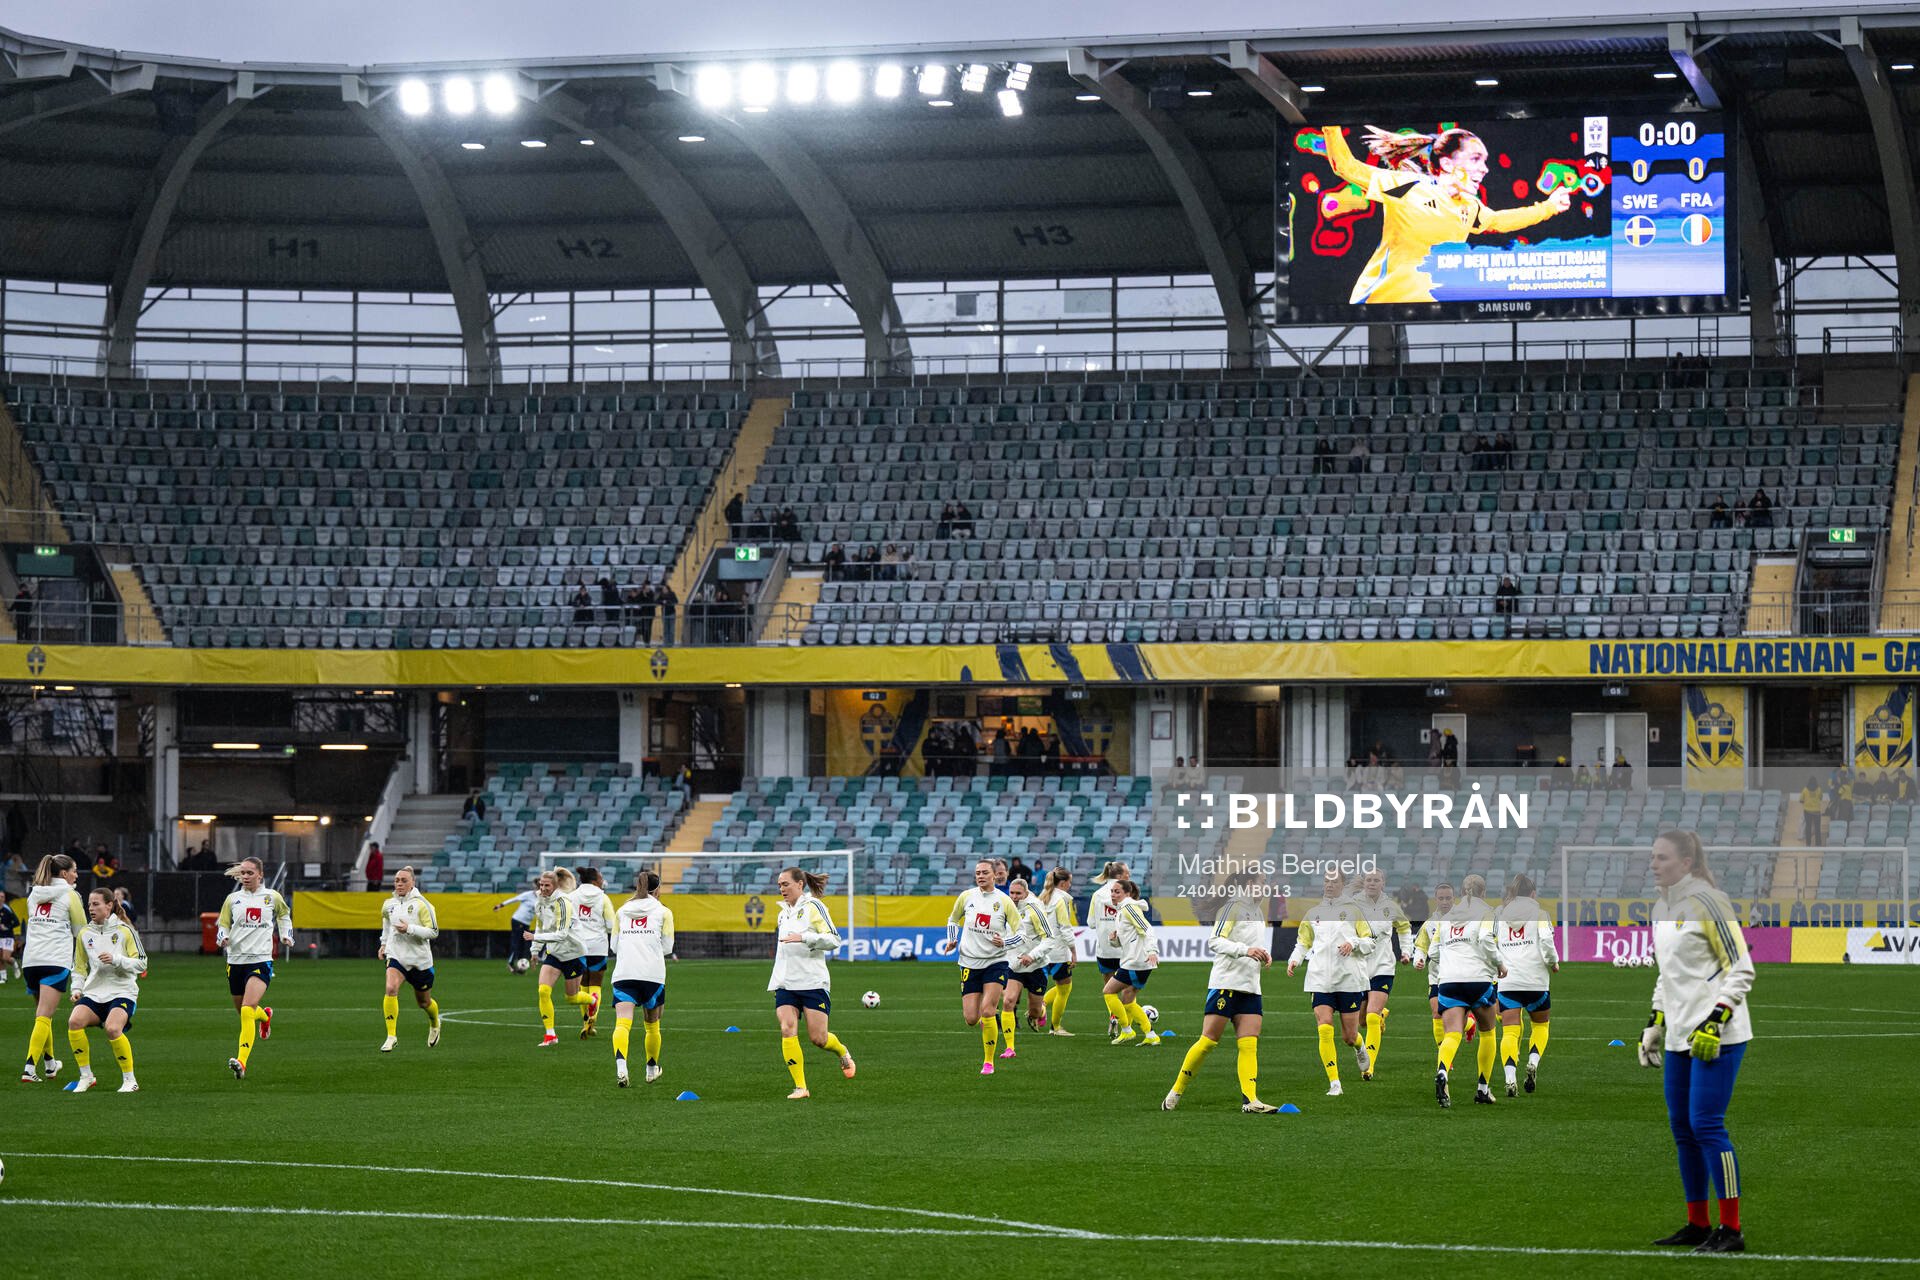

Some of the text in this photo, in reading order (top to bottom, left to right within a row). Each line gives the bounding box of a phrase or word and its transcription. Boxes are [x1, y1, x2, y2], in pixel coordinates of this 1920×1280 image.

[1639, 121, 1696, 146] 0:00
[1632, 159, 1648, 183] 0
[1689, 157, 1704, 181] 0
[1622, 193, 1658, 209] SWE
[1680, 192, 1713, 208] FRA
[1013, 225, 1075, 246] H3
[267, 238, 319, 258] H1
[556, 238, 621, 259] H2
[1491, 253, 1516, 267] NYA
[1478, 301, 1532, 313] SAMSUNG
[1590, 642, 1855, 674] NATIONALARENAN
[1884, 641, 1920, 673] GA
[1434, 688, 1445, 696] G4
